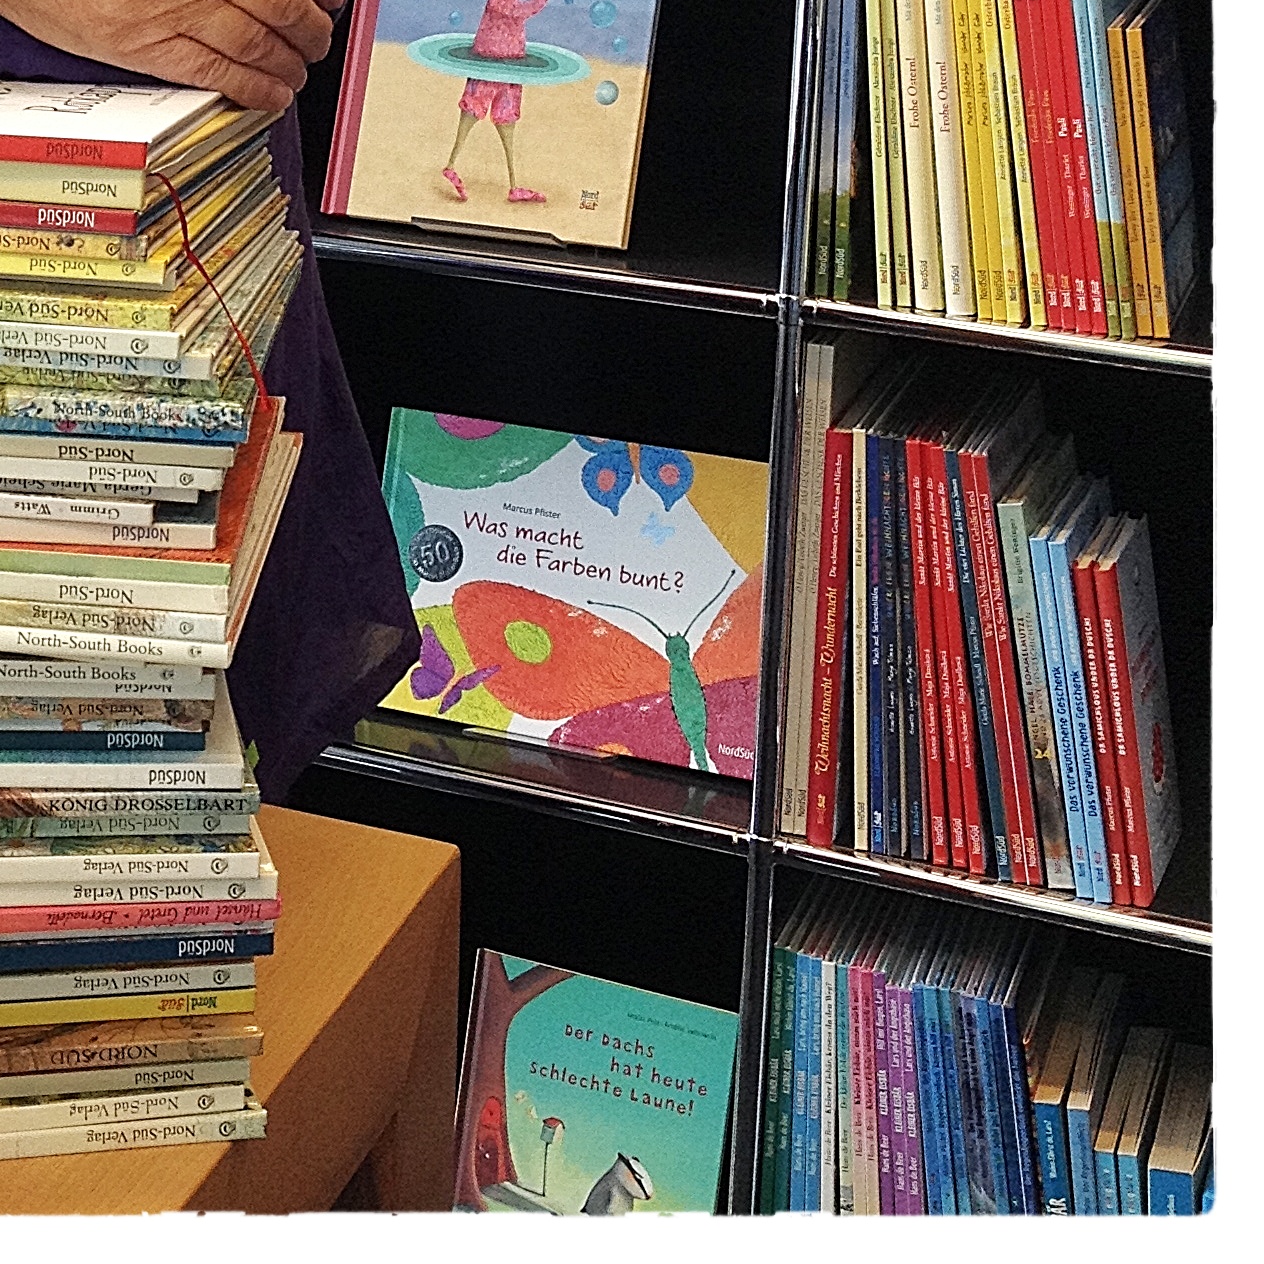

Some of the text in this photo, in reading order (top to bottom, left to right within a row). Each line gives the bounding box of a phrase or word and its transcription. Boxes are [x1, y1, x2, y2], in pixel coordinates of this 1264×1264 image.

[939, 104, 951, 133] Frohe
[62, 180, 117, 197] NordSüd
[37, 208, 95, 228] NordSüd
[503, 503, 561, 519] Marcus Pfister
[463, 511, 584, 550] Was macht
[420, 543, 450, 566] 50
[497, 546, 684, 593] die Farben bunt?
[1051, 666, 1068, 715] Geschenk
[114, 796, 248, 812] DROSSELBART
[1067, 796, 1080, 812] Das
[601, 1034, 655, 1058] Dachs
[611, 1057, 708, 1096] hat heute
[631, 1088, 694, 1116] Laune!
